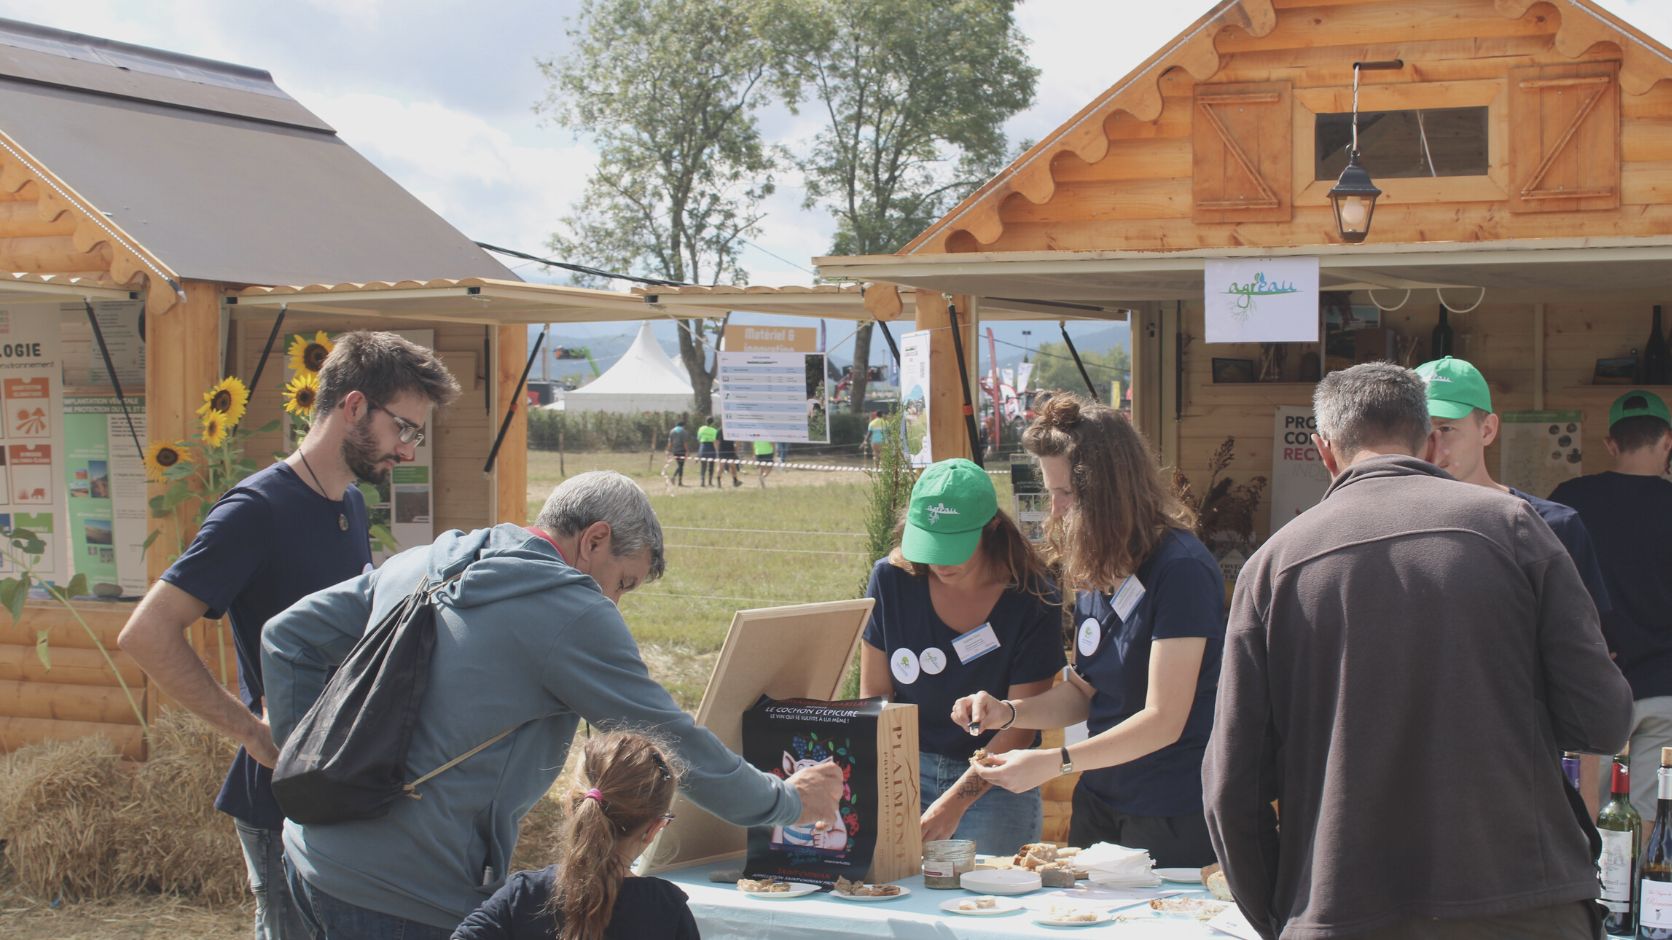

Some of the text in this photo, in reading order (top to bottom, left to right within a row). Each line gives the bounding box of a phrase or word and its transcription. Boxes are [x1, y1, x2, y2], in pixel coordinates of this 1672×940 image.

[0, 342, 42, 358] OGIE
[1285, 415, 1317, 429] PRO
[776, 707, 815, 715] COCHON
[891, 726, 906, 863] PLAIMONT
